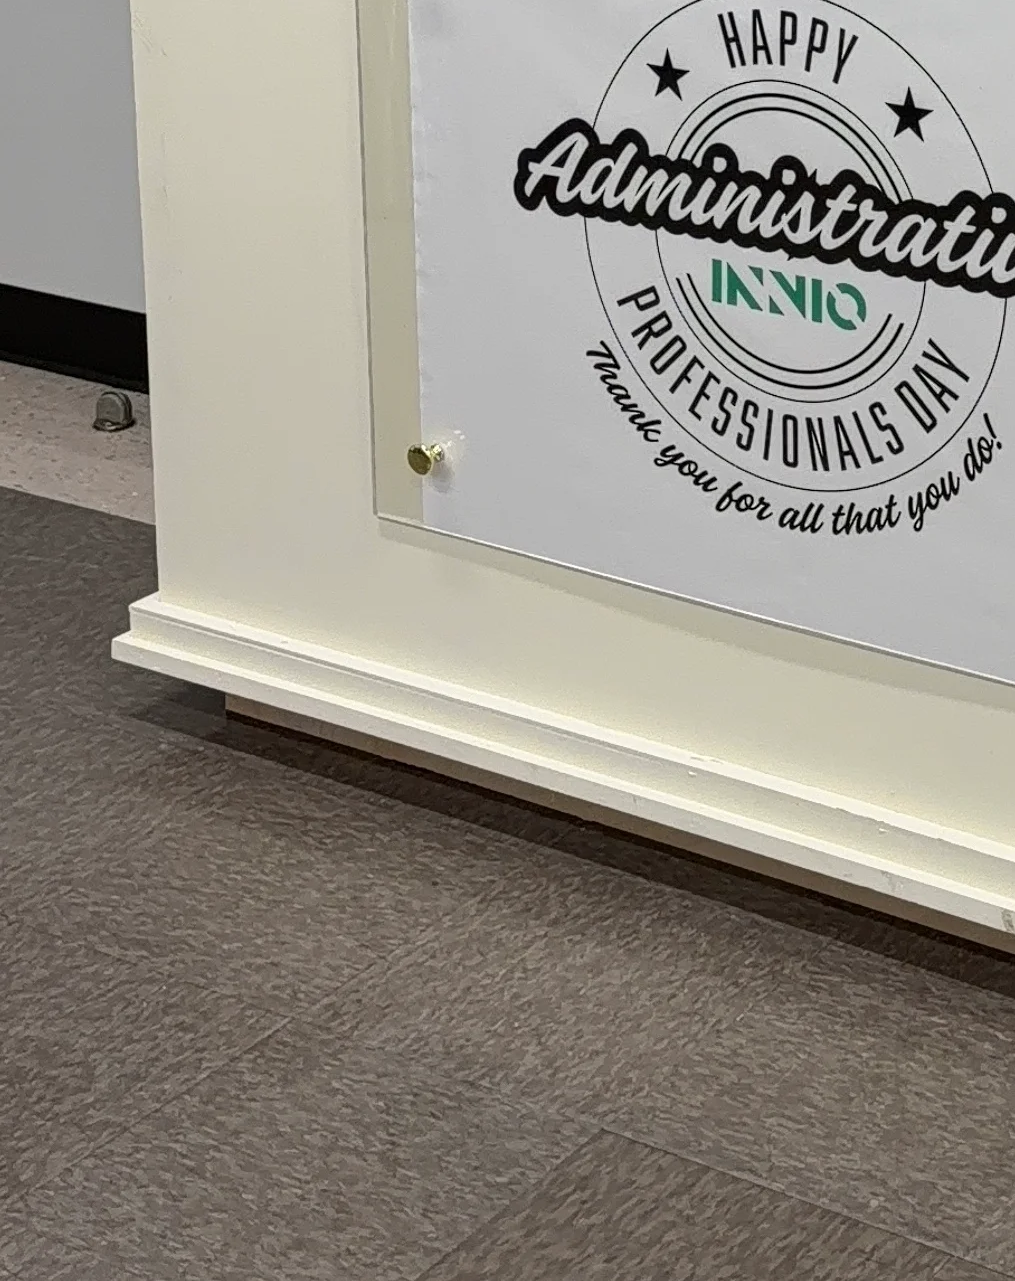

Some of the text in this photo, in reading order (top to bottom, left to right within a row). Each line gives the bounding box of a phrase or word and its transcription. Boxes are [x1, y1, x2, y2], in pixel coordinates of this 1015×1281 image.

[717, 8, 859, 85] HAPPY
[711, 258, 867, 332] INNIO
[586, 340, 1003, 536] Thank you for all that you do!
[616, 285, 970, 472] PROFESSIONALS DAY
